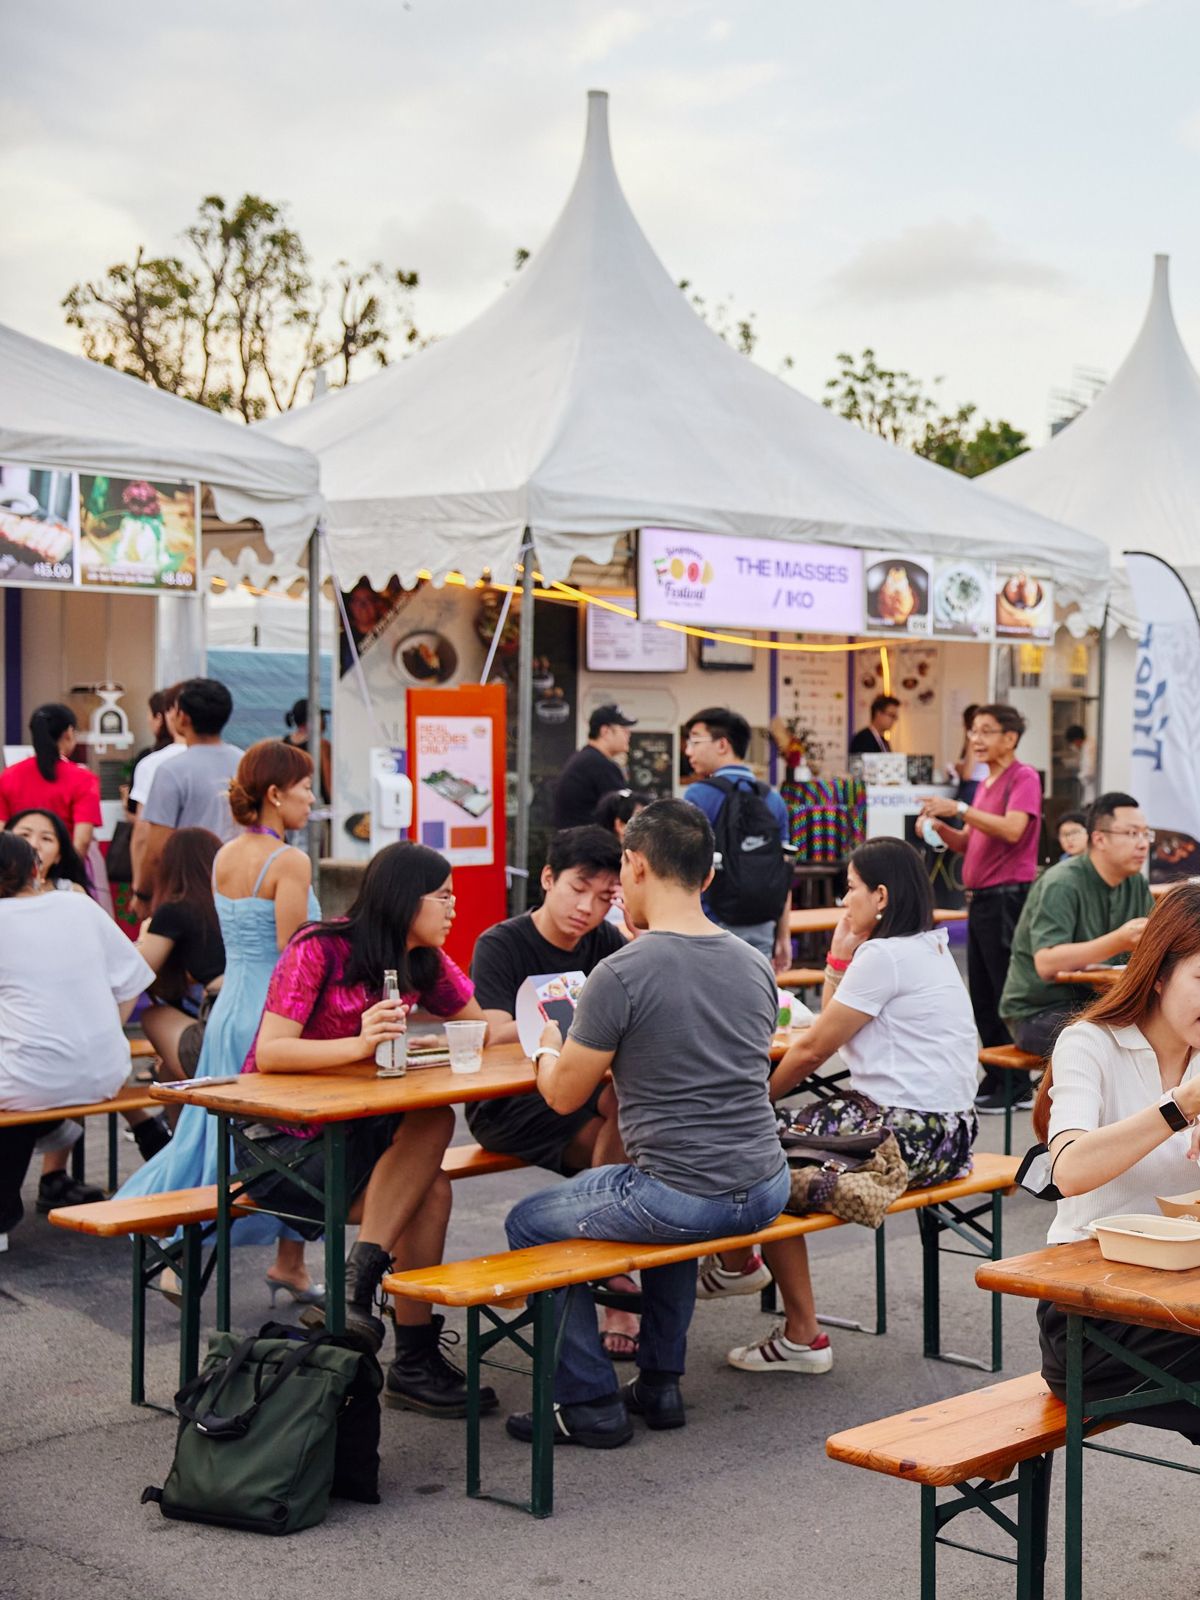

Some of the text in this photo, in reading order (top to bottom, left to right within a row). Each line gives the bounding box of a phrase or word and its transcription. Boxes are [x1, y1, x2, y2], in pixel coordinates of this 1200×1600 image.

[735, 555, 849, 583] THE MASSES
[786, 591, 814, 609] IKO
